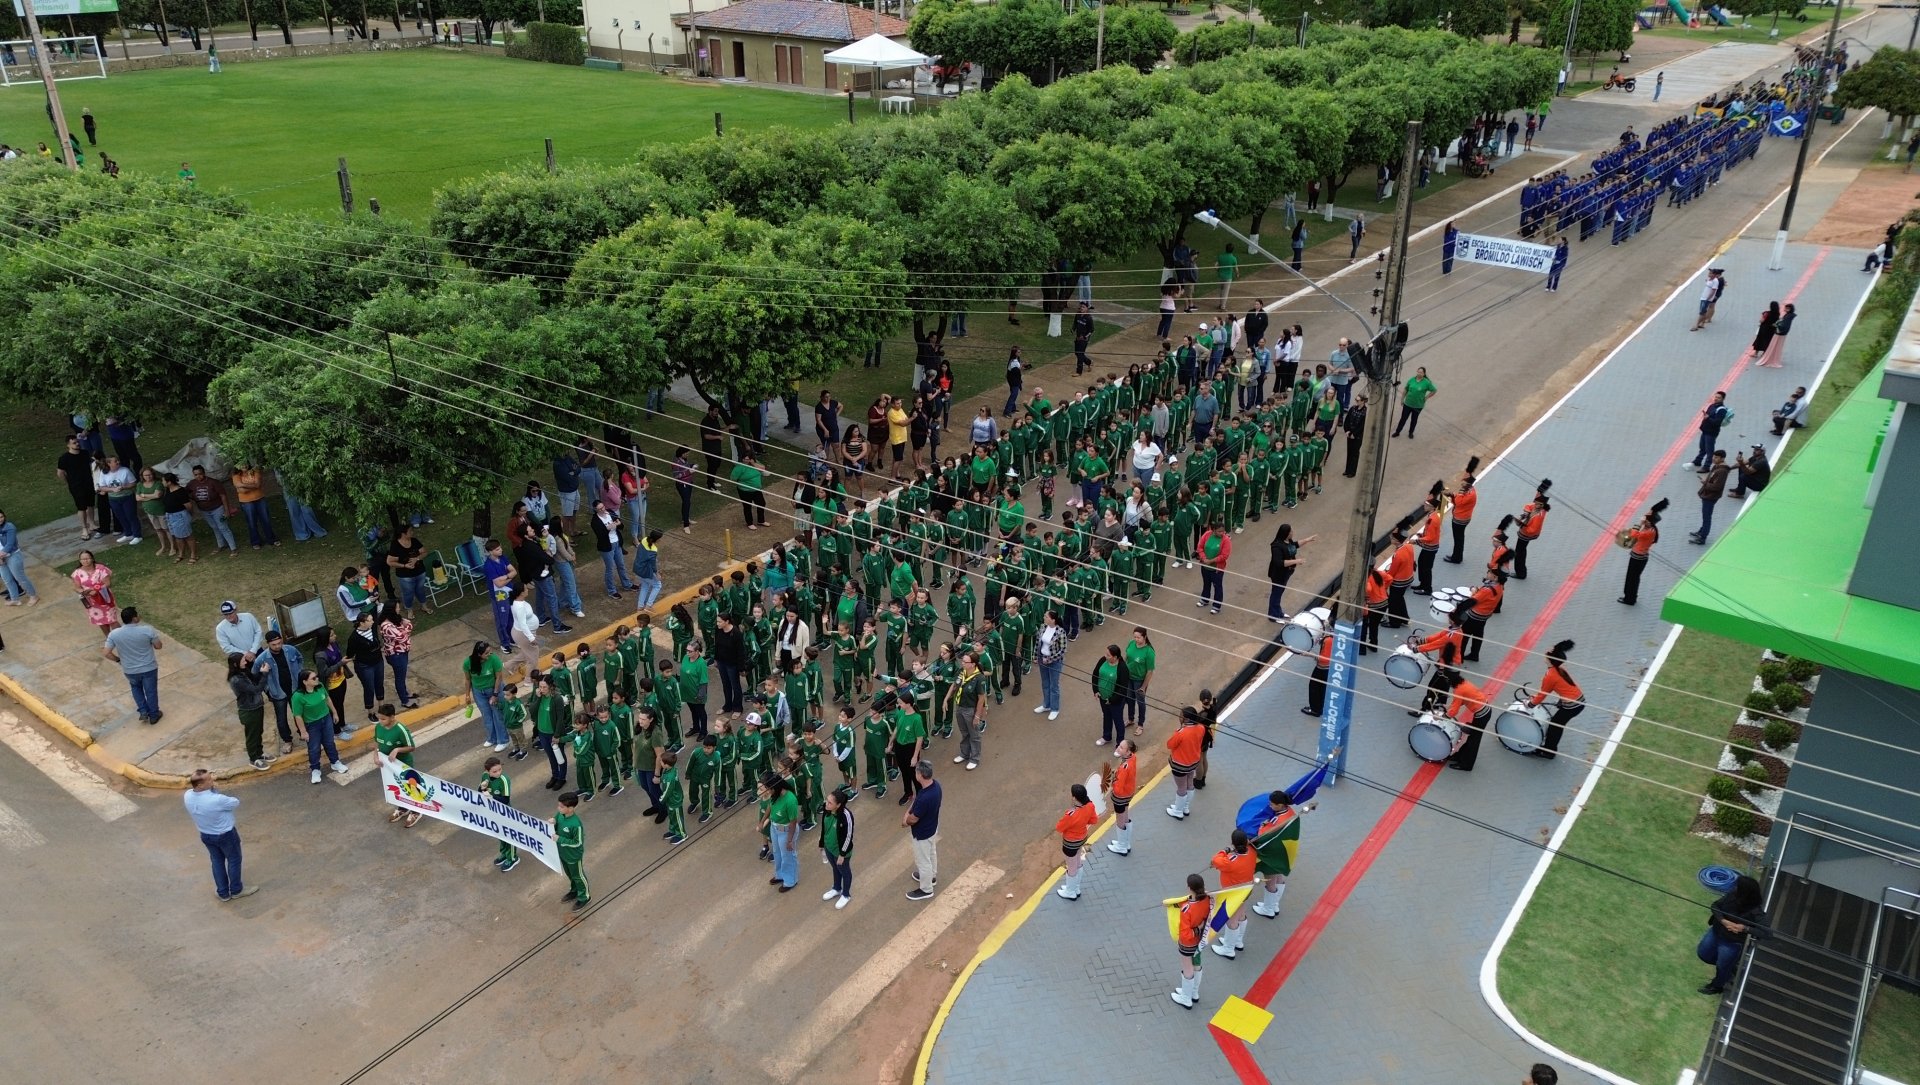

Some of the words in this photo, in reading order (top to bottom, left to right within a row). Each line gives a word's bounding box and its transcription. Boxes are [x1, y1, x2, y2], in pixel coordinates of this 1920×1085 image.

[1471, 239, 1489, 248] ESCOLA
[1489, 241, 1514, 252] ESTADUAL
[1475, 248, 1509, 263] BROMILDO
[1511, 254, 1544, 269] LAWISCH
[1335, 634, 1346, 660] RUA
[1332, 664, 1344, 686] DAS
[1326, 692, 1341, 740] FLORES
[440, 780, 486, 808] ESCOLA
[487, 798, 553, 839] MUNICIPAL
[460, 809, 501, 834] PAULO
[502, 825, 545, 856] FREIRE
